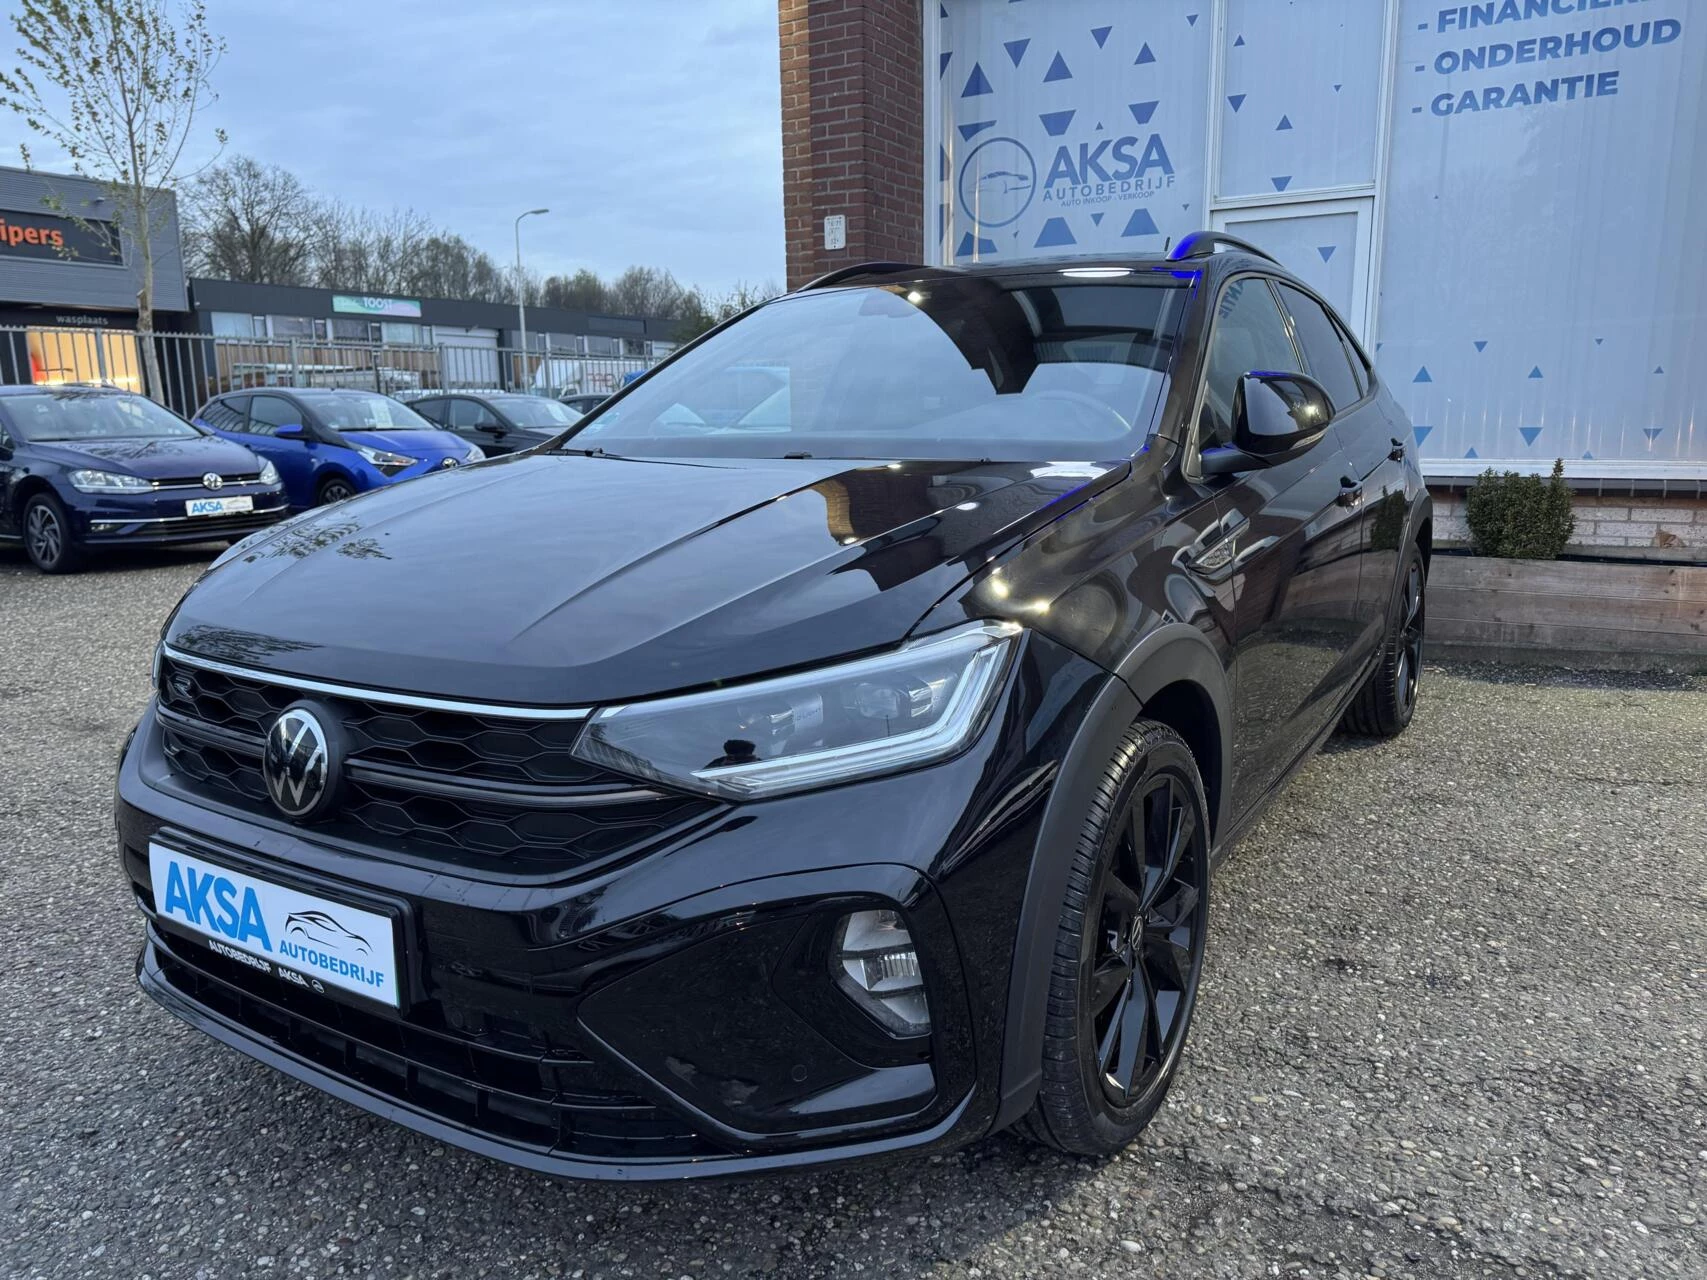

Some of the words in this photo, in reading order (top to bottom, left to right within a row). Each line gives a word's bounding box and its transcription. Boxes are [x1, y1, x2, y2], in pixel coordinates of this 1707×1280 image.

[1437, 0, 1650, 34] FINANCI
[1434, 18, 1682, 76] ONDERHOUD
[1431, 70, 1620, 117] GARANTIE
[1043, 133, 1175, 189] AKSA
[1043, 175, 1176, 202] AUTOBEDRIJF
[1060, 198, 1081, 208] AUTO
[1083, 194, 1113, 206] INKOOP
[1118, 190, 1155, 201] VERKOOP
[55, 314, 109, 327] wasplaats
[192, 500, 224, 514] AKSA
[165, 860, 273, 953] AKSA
[208, 939, 272, 974] AUTOBEDRIJF
[278, 967, 310, 989] AKSA
[279, 940, 384, 987] AUTOBEDRIJF
